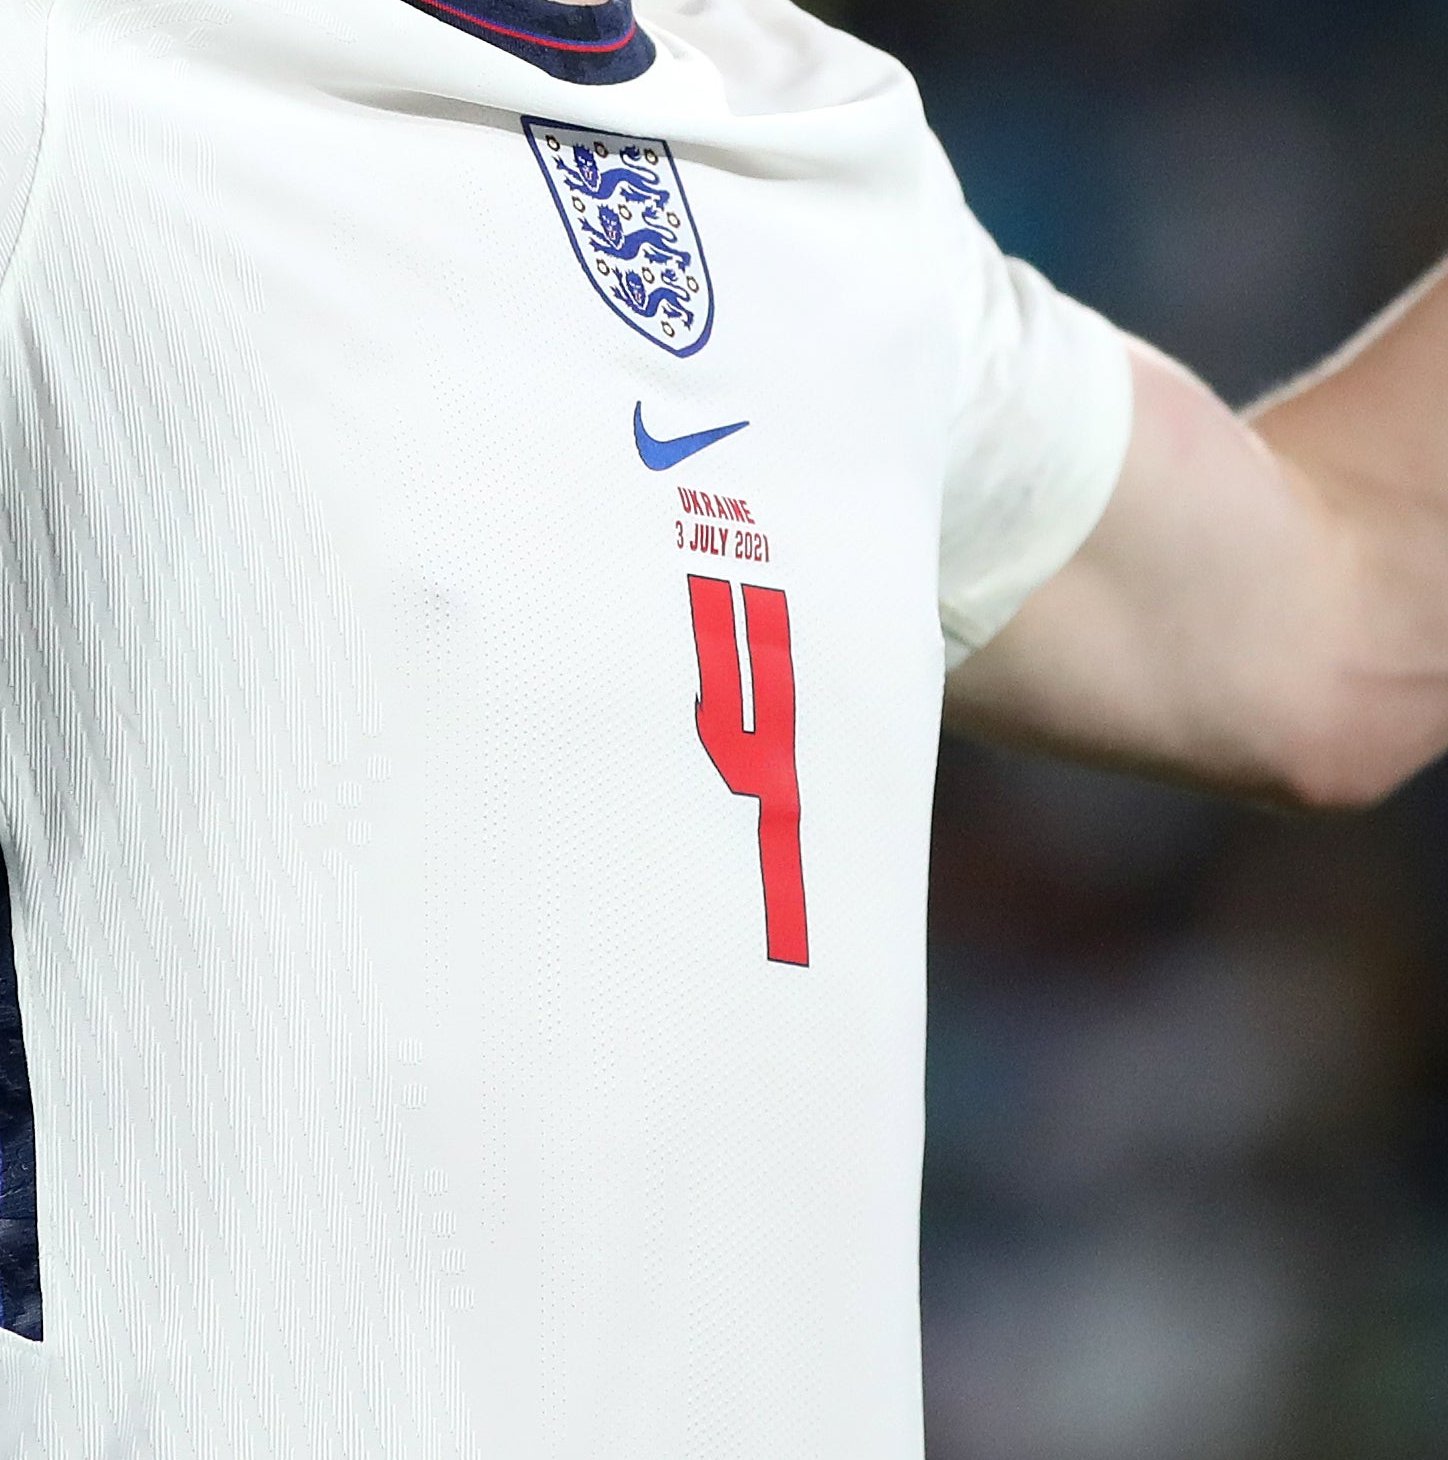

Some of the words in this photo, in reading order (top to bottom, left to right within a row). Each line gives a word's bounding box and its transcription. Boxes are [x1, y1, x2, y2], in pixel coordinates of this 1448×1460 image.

[677, 486, 755, 524] UKRAINE
[675, 520, 684, 549] 3
[690, 523, 728, 556] JULY
[735, 530, 769, 563] 2021
[687, 573, 809, 967] 4
